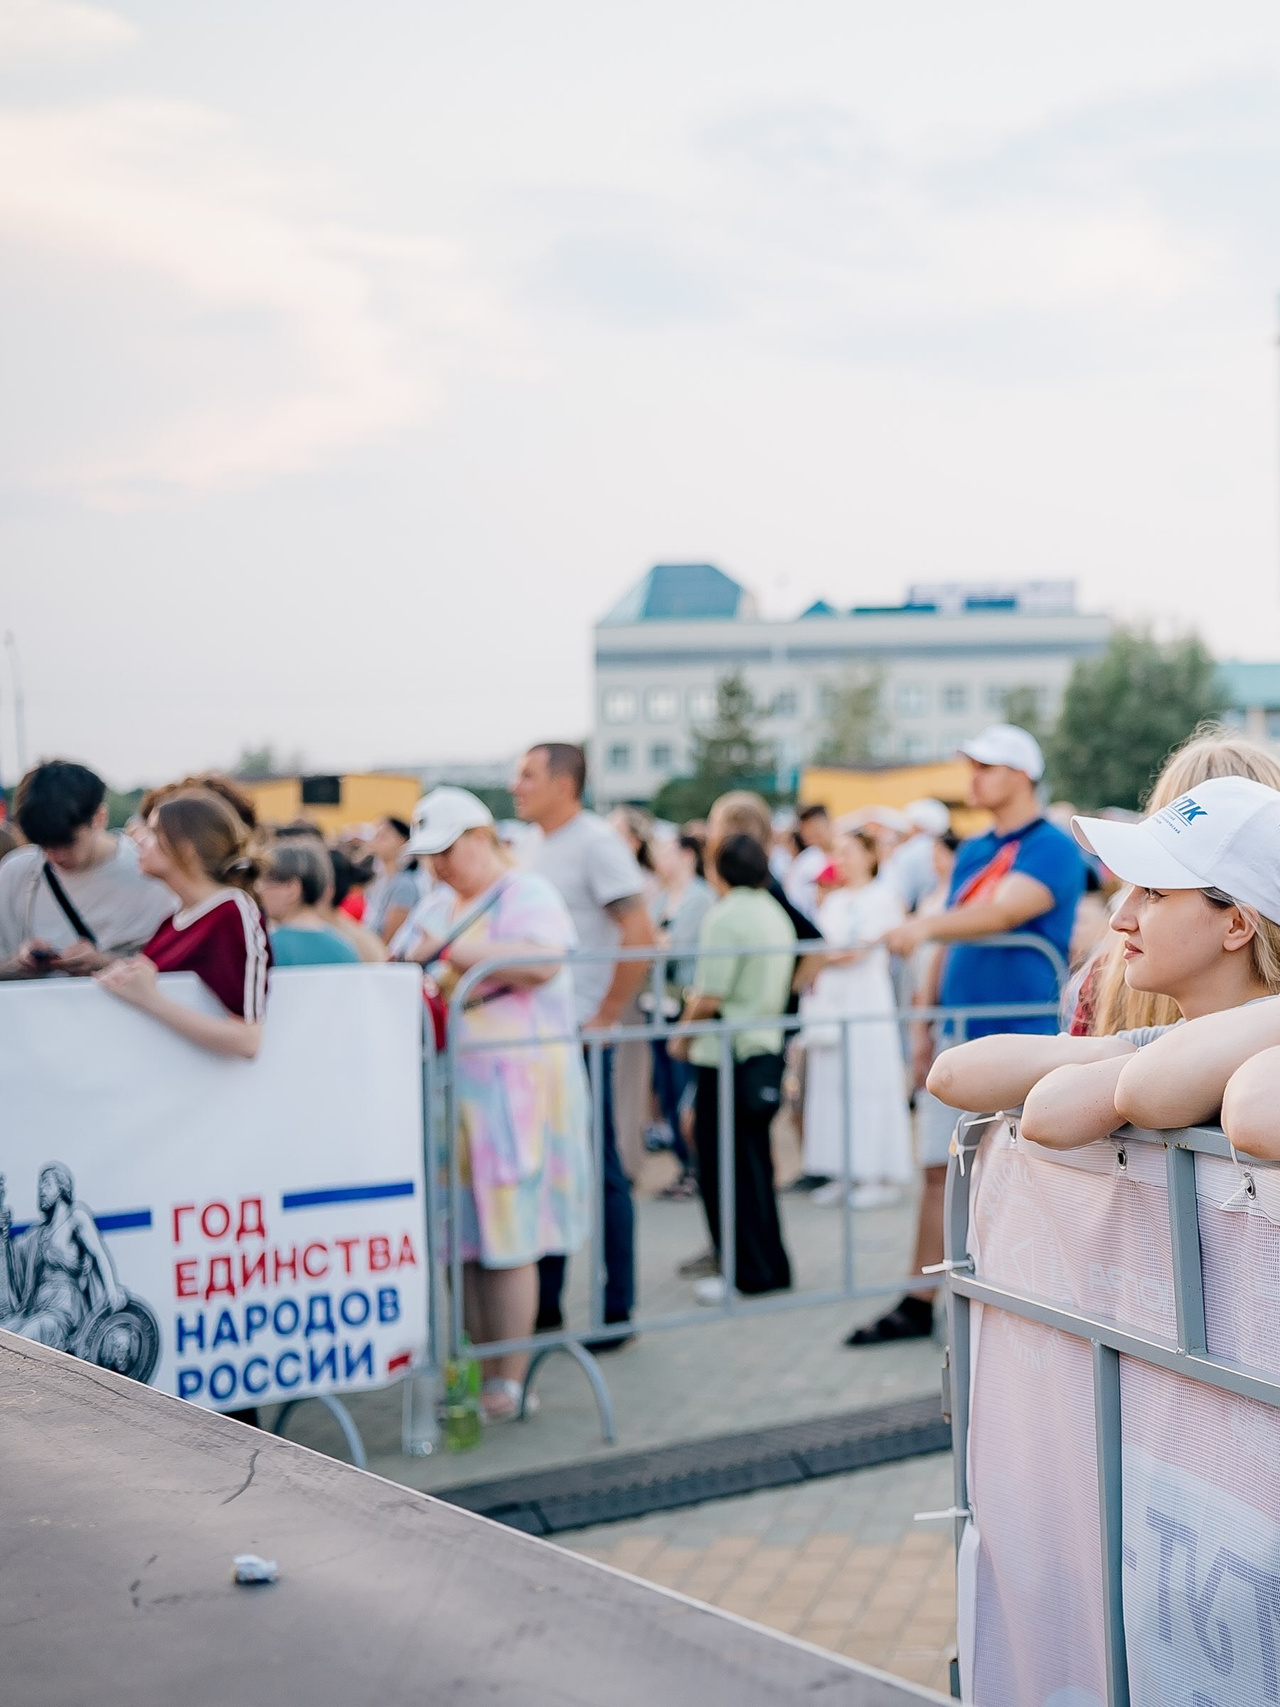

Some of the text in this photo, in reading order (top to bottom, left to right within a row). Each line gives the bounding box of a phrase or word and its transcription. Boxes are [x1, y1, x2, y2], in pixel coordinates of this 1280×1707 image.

[172, 1199, 267, 1243] ГОД
[174, 1233, 416, 1301] ЕДИНСТВА
[177, 1287, 401, 1354] НАРОДОВ
[178, 1341, 373, 1401] РОССИИ
